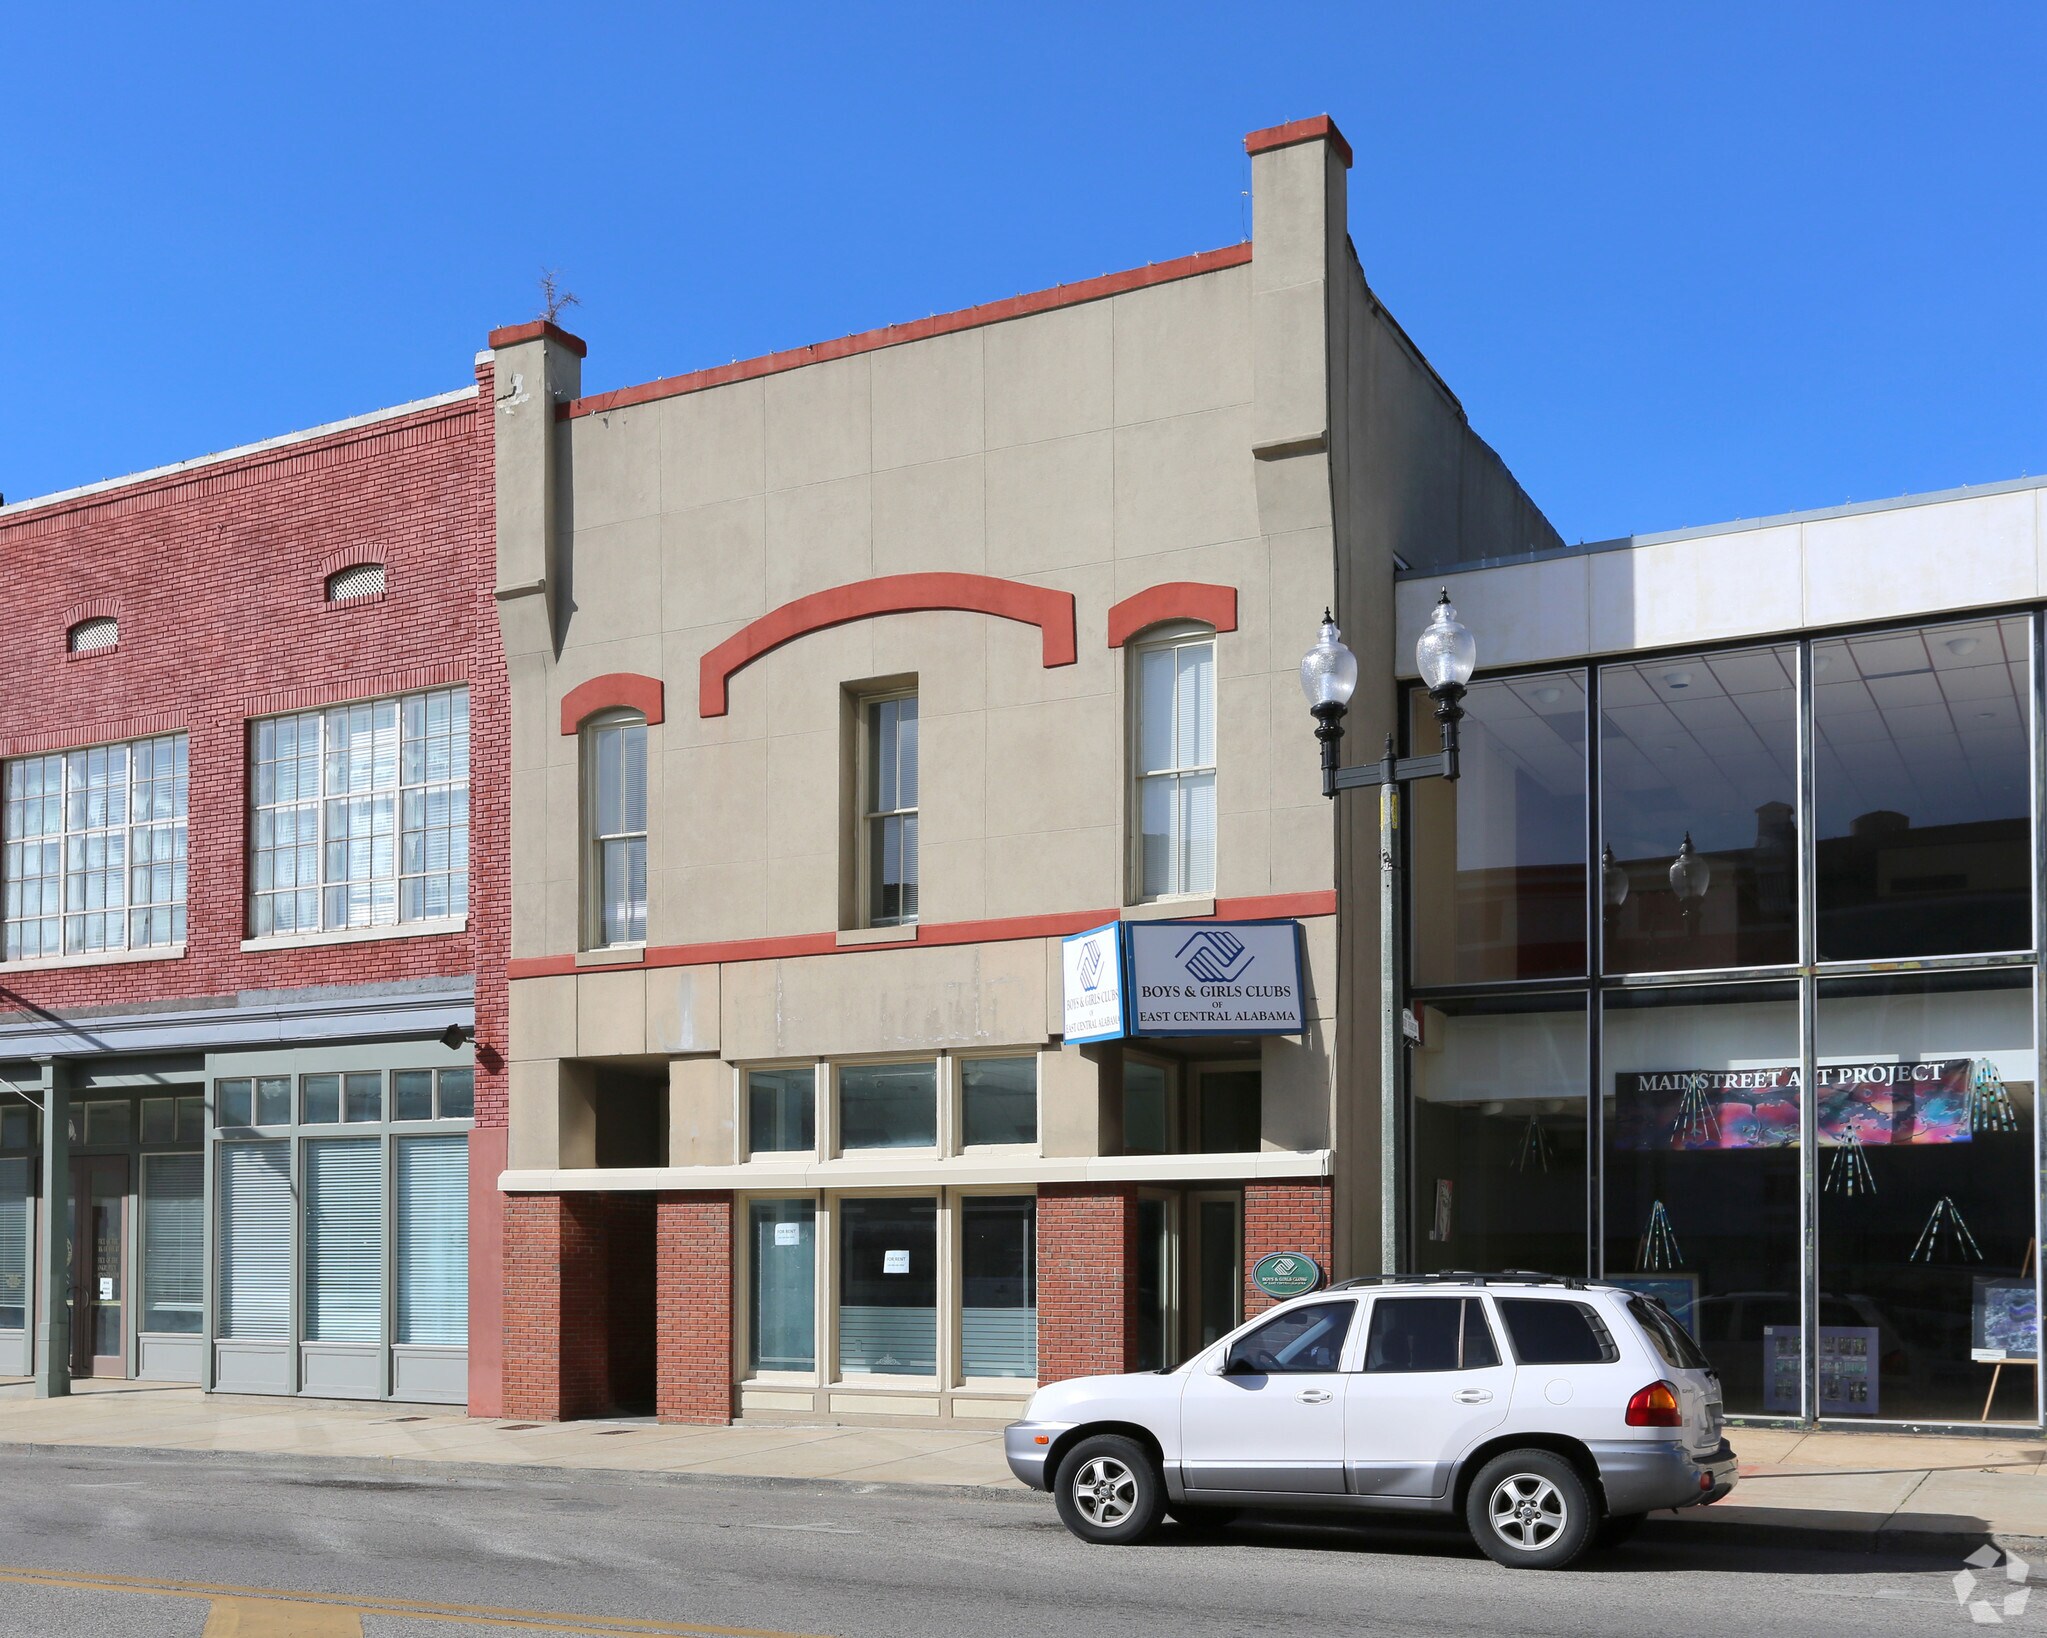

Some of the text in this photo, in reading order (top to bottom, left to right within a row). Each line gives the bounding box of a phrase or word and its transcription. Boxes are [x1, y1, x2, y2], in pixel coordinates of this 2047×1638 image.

[1142, 985, 1291, 998] BOYS & GIRLS CLUBS
[1067, 989, 1118, 1011] BOYS & GIRLS CLUBS
[1139, 1010, 1295, 1022] EAST CENTRAL ALABAMA
[1066, 1023, 1076, 1034] EAST
[1077, 1019, 1097, 1031] CENTRAL
[1638, 1063, 1945, 1091] MAINSTREET AT PROJECT
